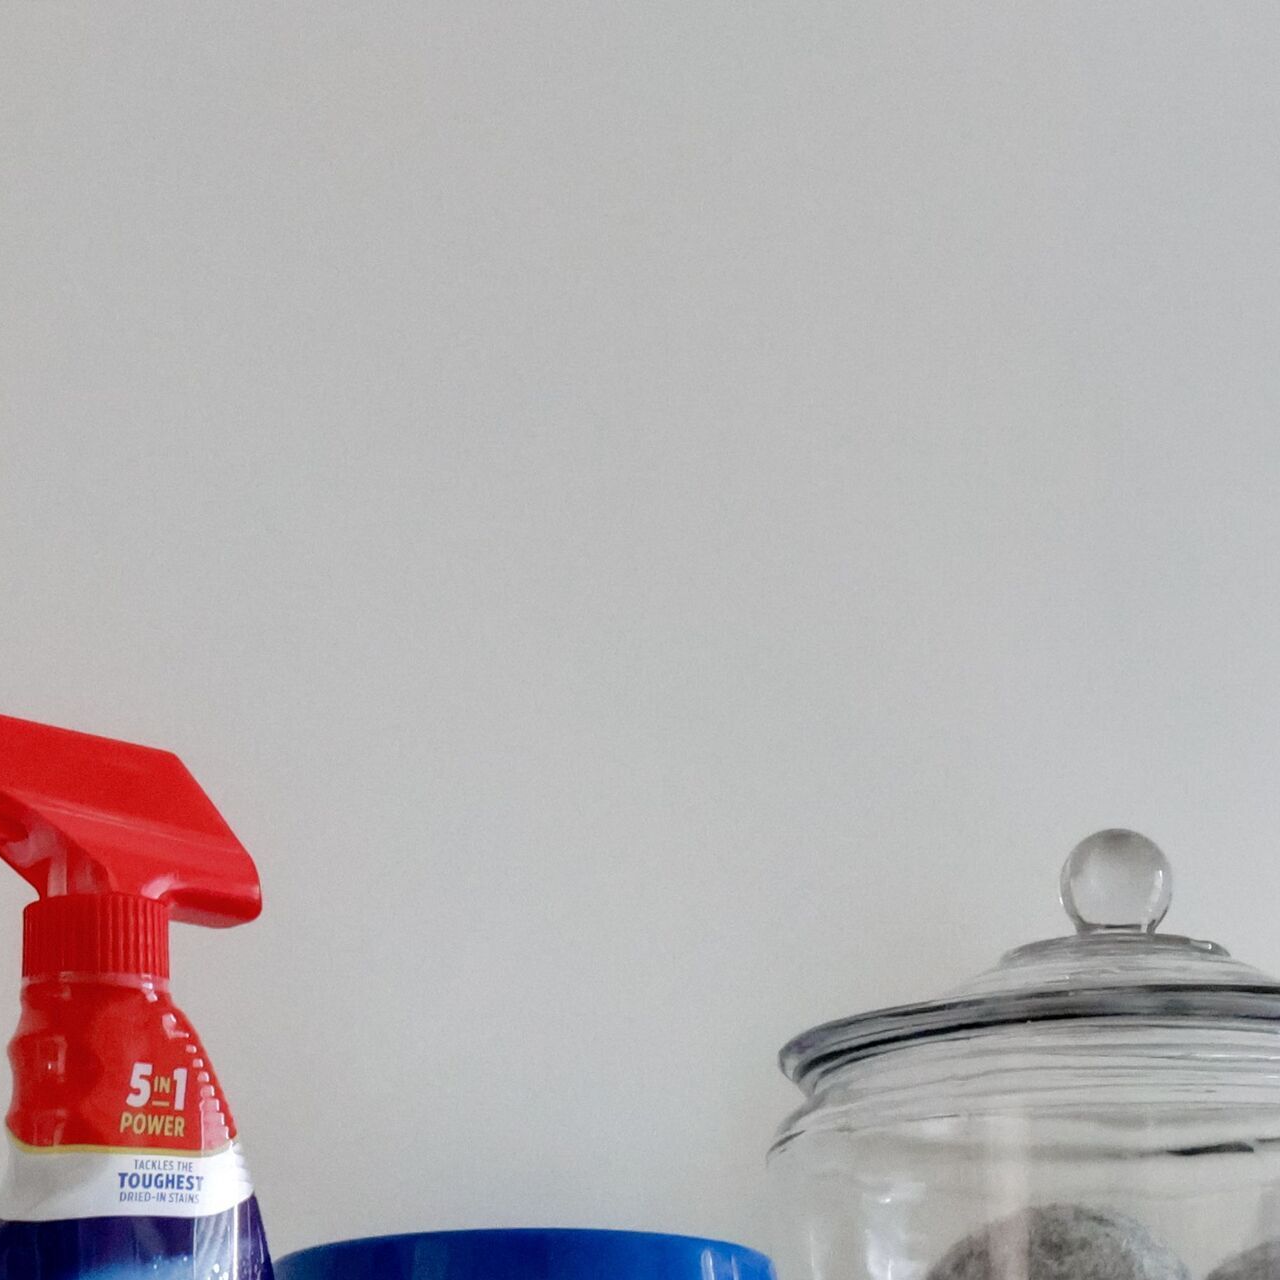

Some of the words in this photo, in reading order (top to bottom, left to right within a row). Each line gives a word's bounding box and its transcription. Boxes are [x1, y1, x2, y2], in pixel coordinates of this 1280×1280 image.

[126, 1061, 153, 1109] 5
[153, 1075, 171, 1094] IN
[172, 1067, 188, 1111] 1
[120, 1113, 186, 1138] POWER
[134, 1158, 175, 1171] TACKLES
[175, 1159, 193, 1172] THE
[118, 1171, 205, 1192] TOUGHEST
[119, 1191, 167, 1203] DRIED-IN
[168, 1192, 200, 1205] STAINS
